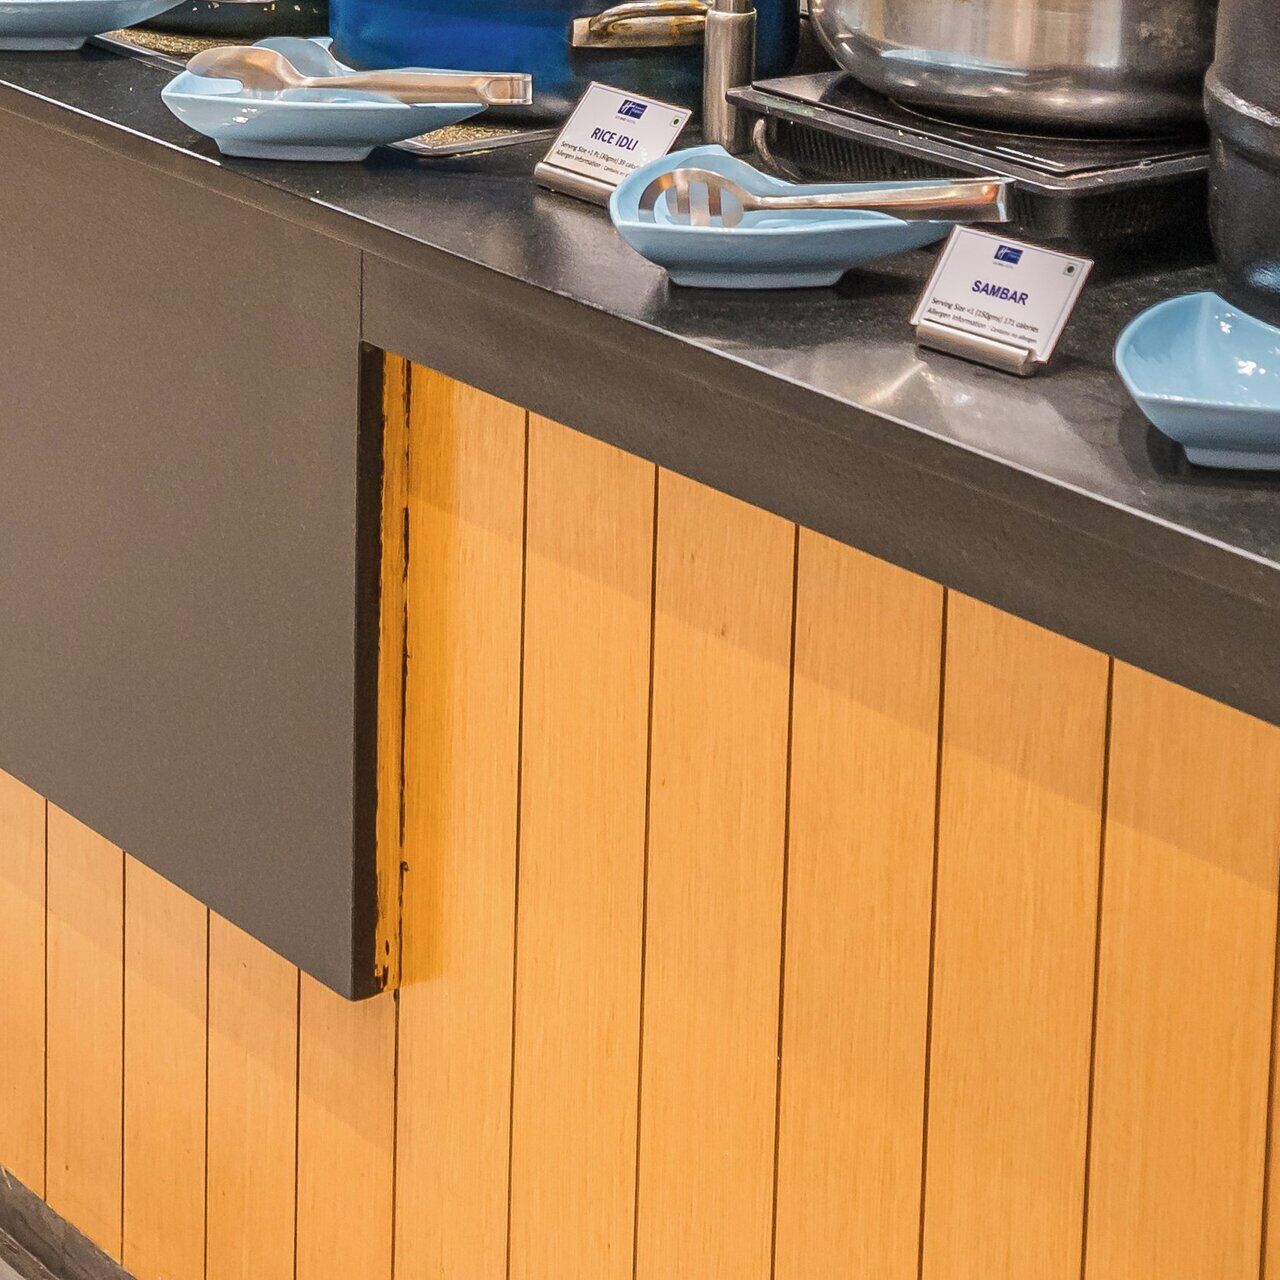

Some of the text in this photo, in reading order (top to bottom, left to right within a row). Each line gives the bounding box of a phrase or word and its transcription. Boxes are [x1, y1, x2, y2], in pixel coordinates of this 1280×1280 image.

[590, 127, 640, 152] RICE IDLI
[931, 297, 954, 310] Serving
[971, 280, 1029, 306] SAMBAR
